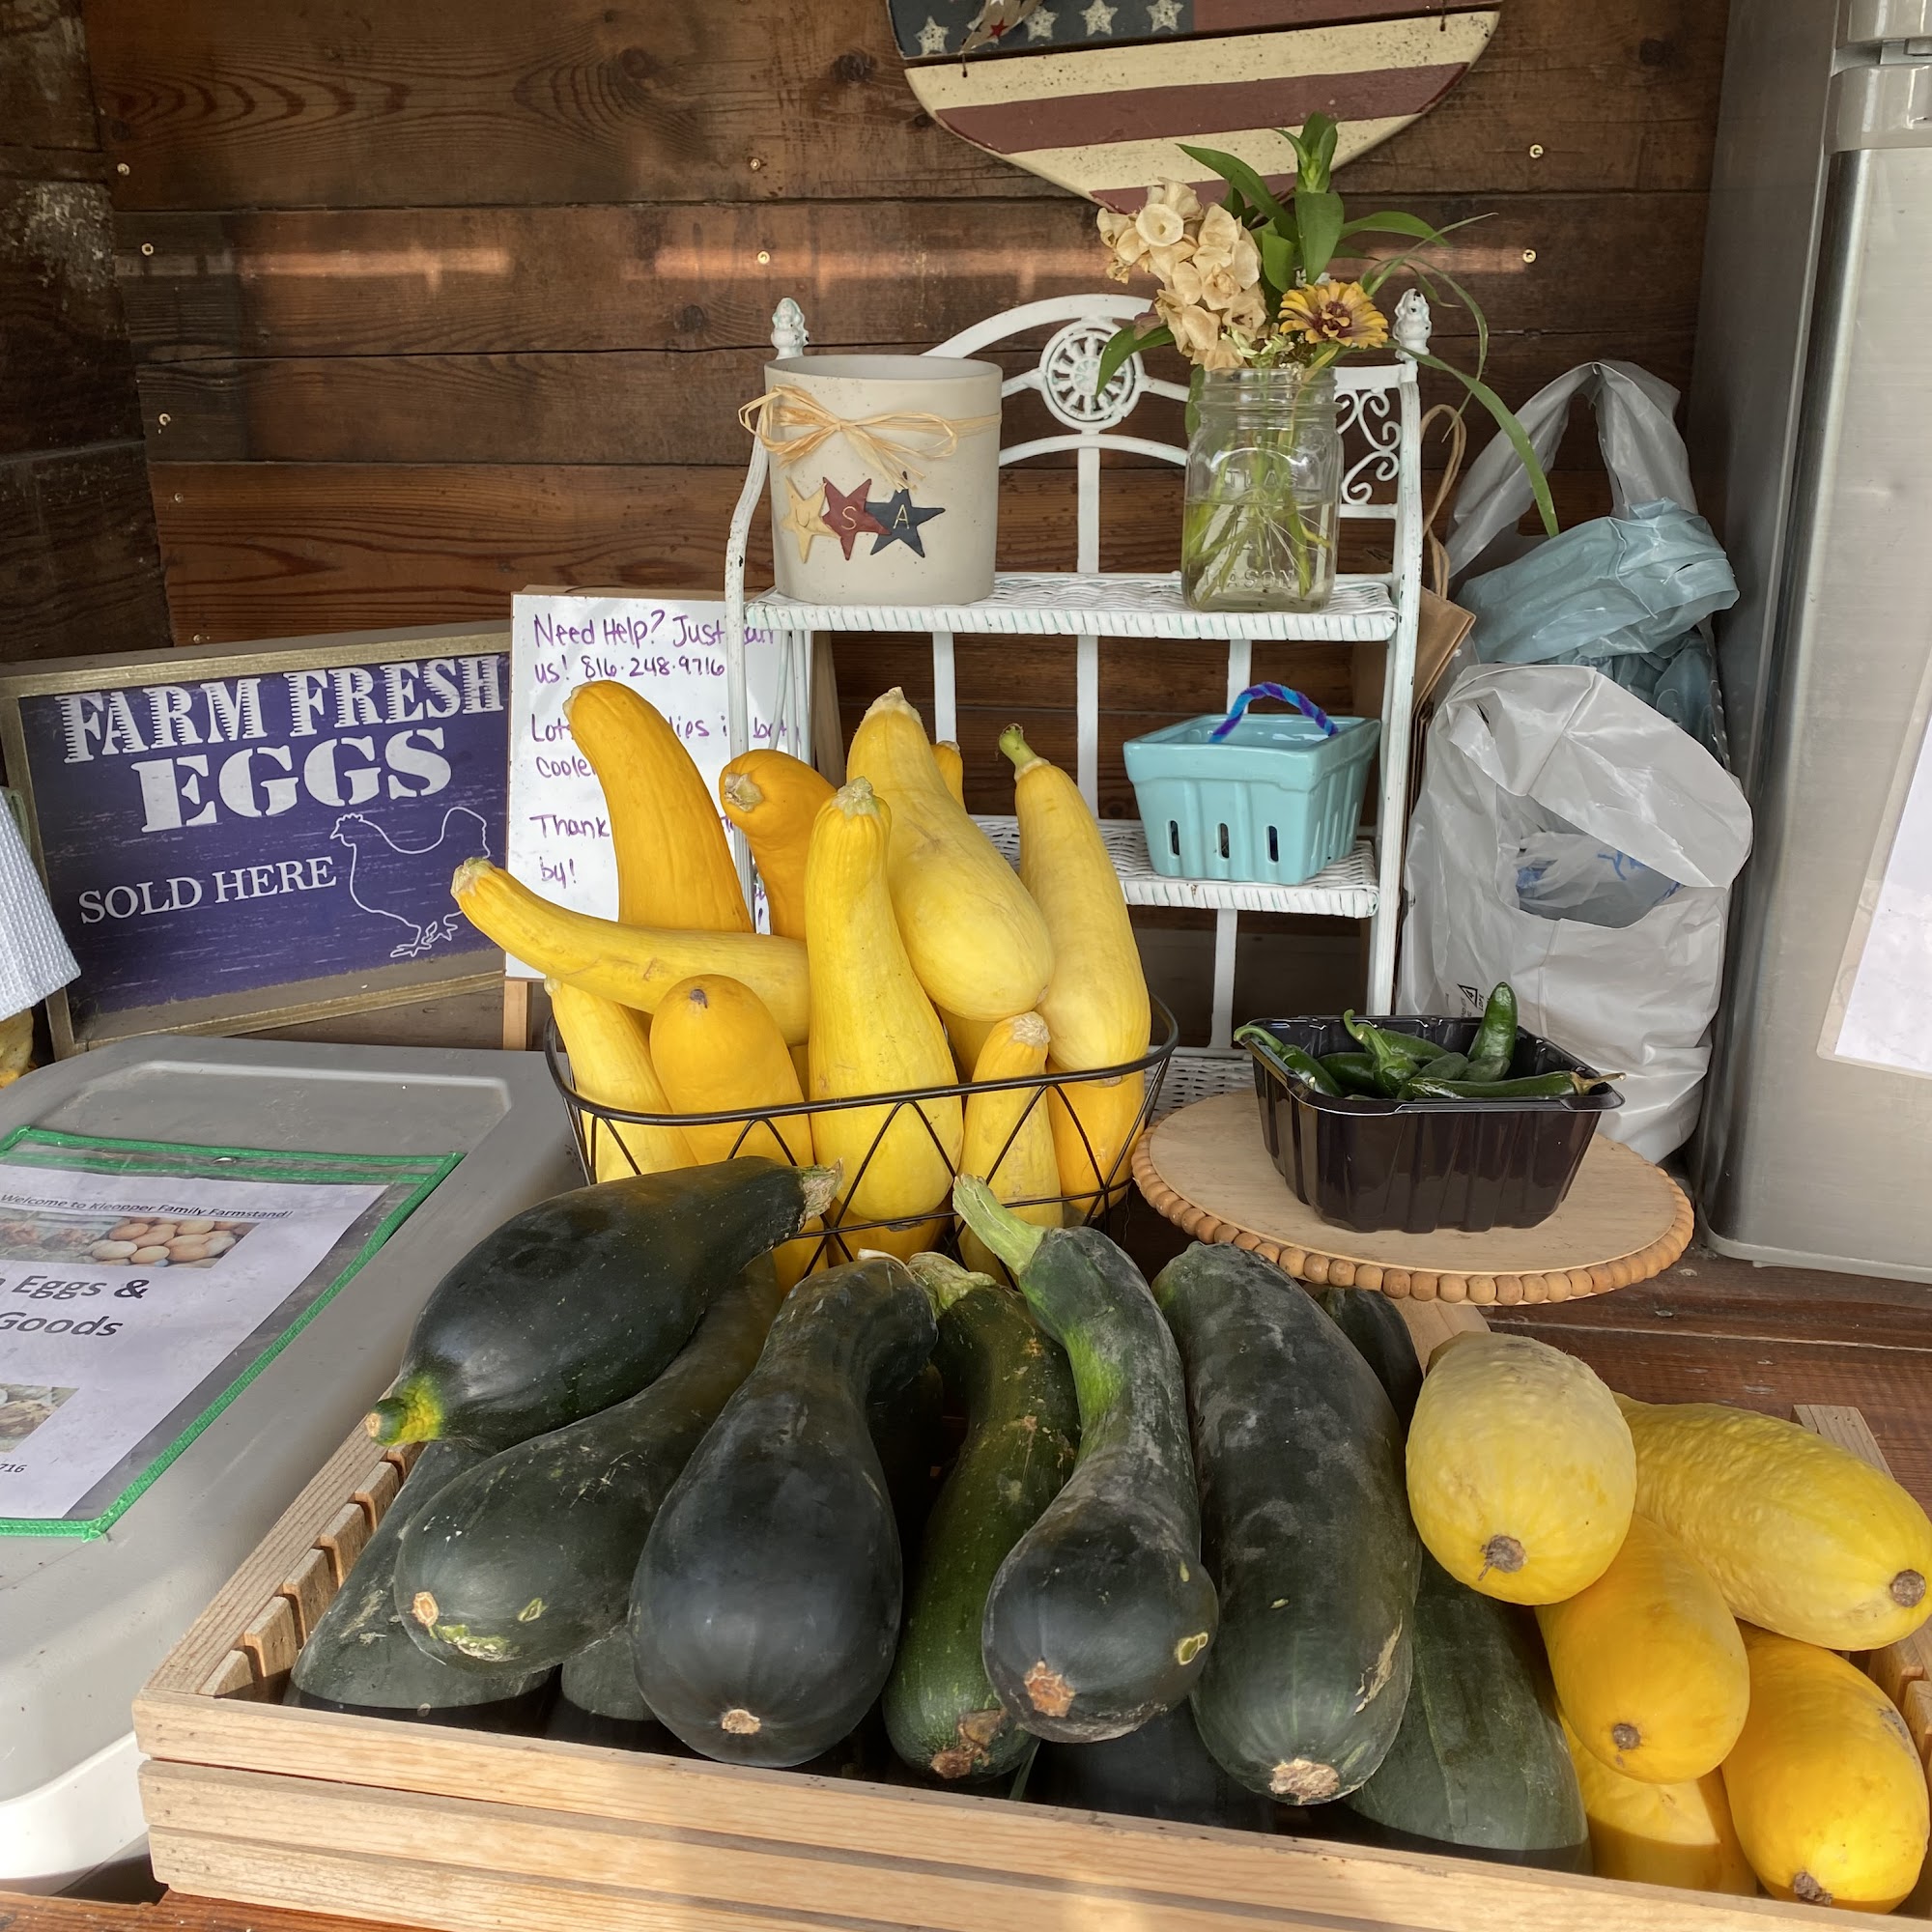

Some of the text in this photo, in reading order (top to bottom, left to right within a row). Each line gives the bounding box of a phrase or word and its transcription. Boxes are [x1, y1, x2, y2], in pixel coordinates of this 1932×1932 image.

[533, 612, 596, 648] Need
[603, 609, 667, 650] Help?
[672, 614, 726, 648] Just
[534, 654, 571, 684] us!
[53, 655, 503, 765] FARM FRESH
[530, 712, 575, 743] Lot
[130, 726, 453, 834] EGGS
[528, 813, 611, 839] Thank
[539, 856, 577, 890] by!
[77, 855, 338, 924] SOLD HERE
[1, 1193, 69, 1208] Welcome
[71, 1201, 87, 1209] to
[156, 1204, 206, 1217] Family
[207, 1208, 294, 1219] Farmstand!
[12, 1275, 107, 1299] Eggs
[113, 1279, 151, 1299] &
[0, 1311, 124, 1337] Goods
